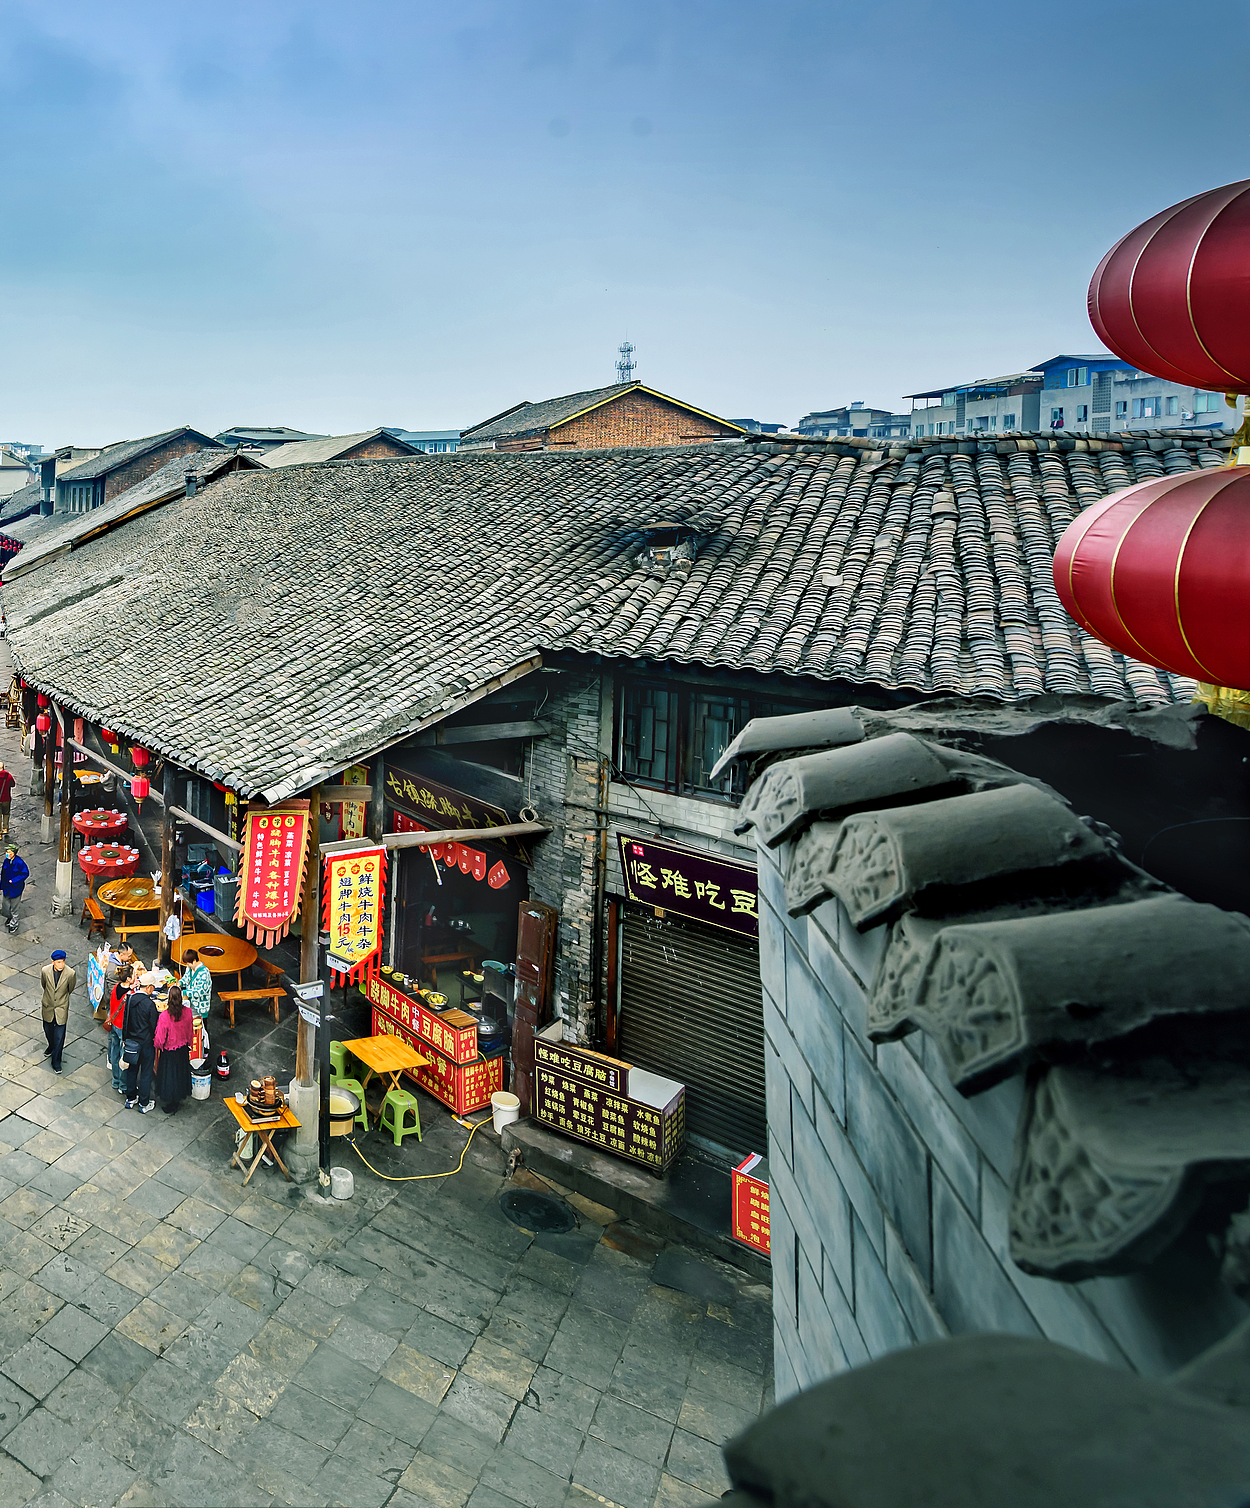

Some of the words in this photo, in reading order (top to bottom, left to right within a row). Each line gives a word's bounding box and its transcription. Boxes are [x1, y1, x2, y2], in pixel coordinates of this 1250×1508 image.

[630, 860, 759, 919] 怪难吃豆
[538, 1047, 607, 1082] 怪难吃豆腐脑
